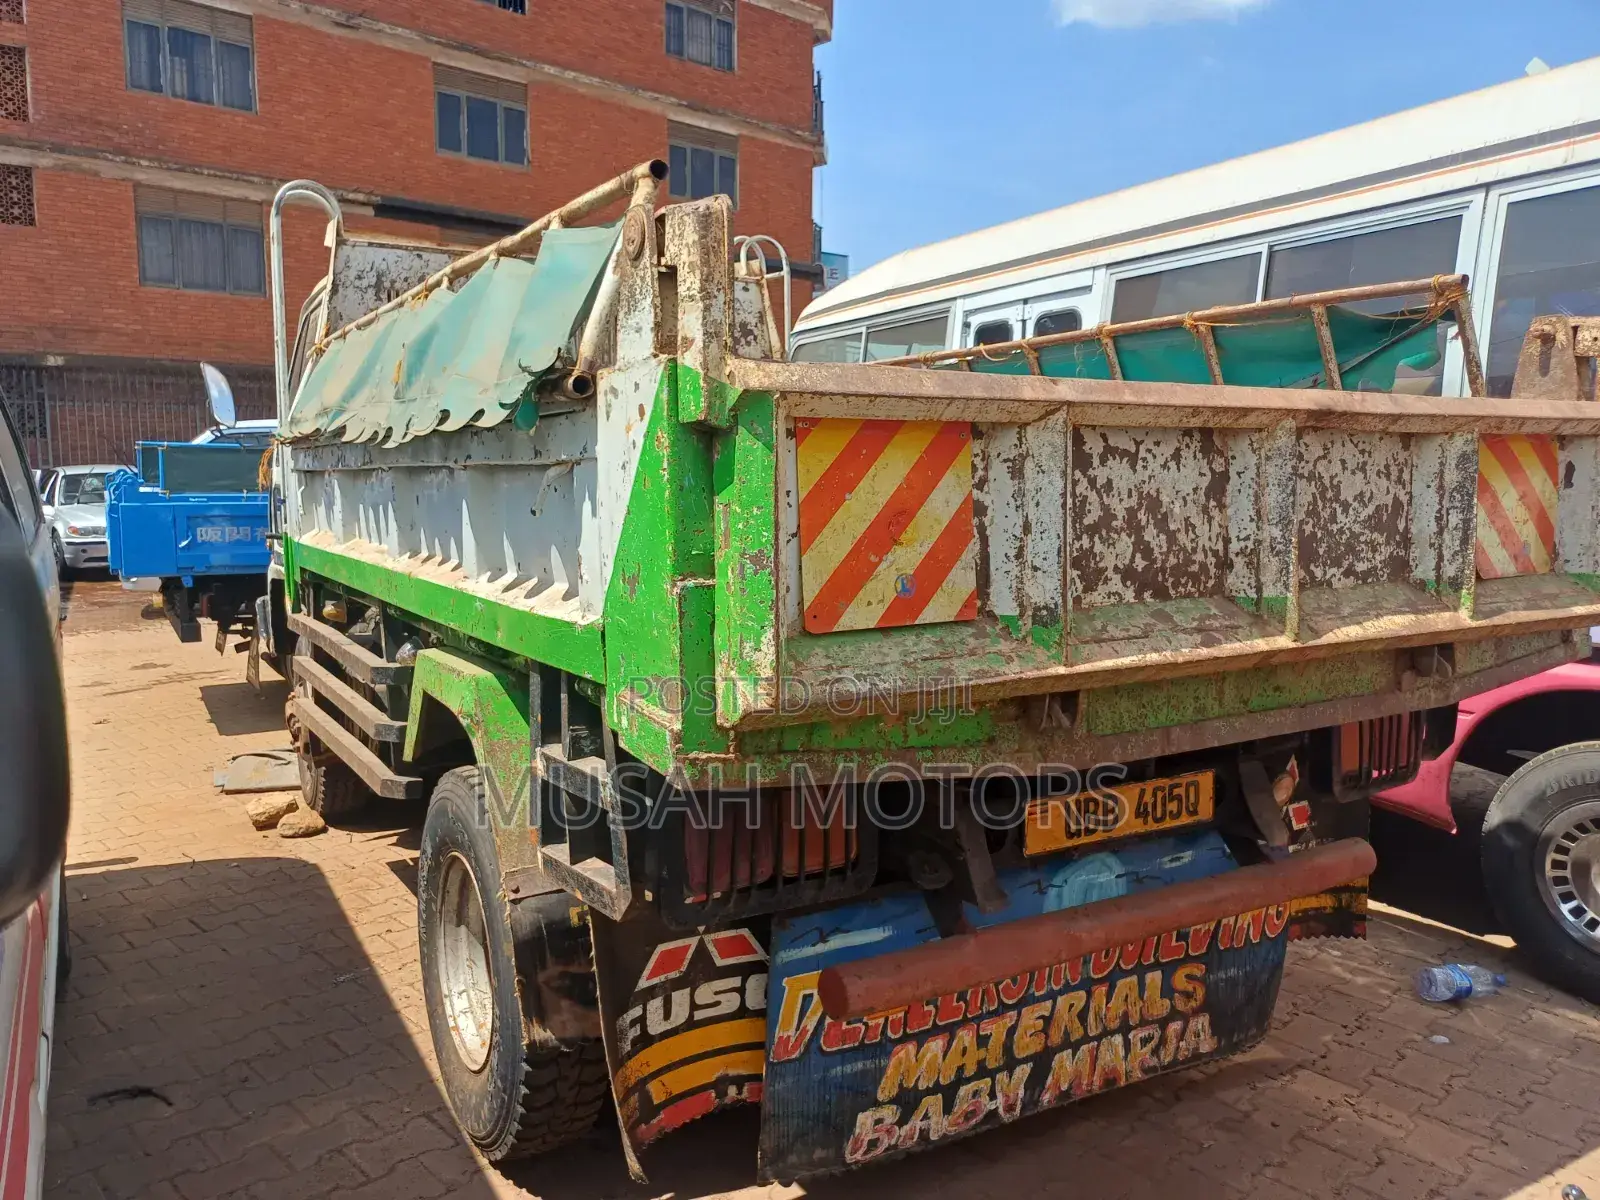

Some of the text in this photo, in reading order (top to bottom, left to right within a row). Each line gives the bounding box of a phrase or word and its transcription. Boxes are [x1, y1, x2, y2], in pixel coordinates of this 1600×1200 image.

[1134, 779, 1200, 826] 405Q
[843, 1012, 1219, 1164] BABY MARIA
[876, 963, 1206, 1102] MATERIALS
